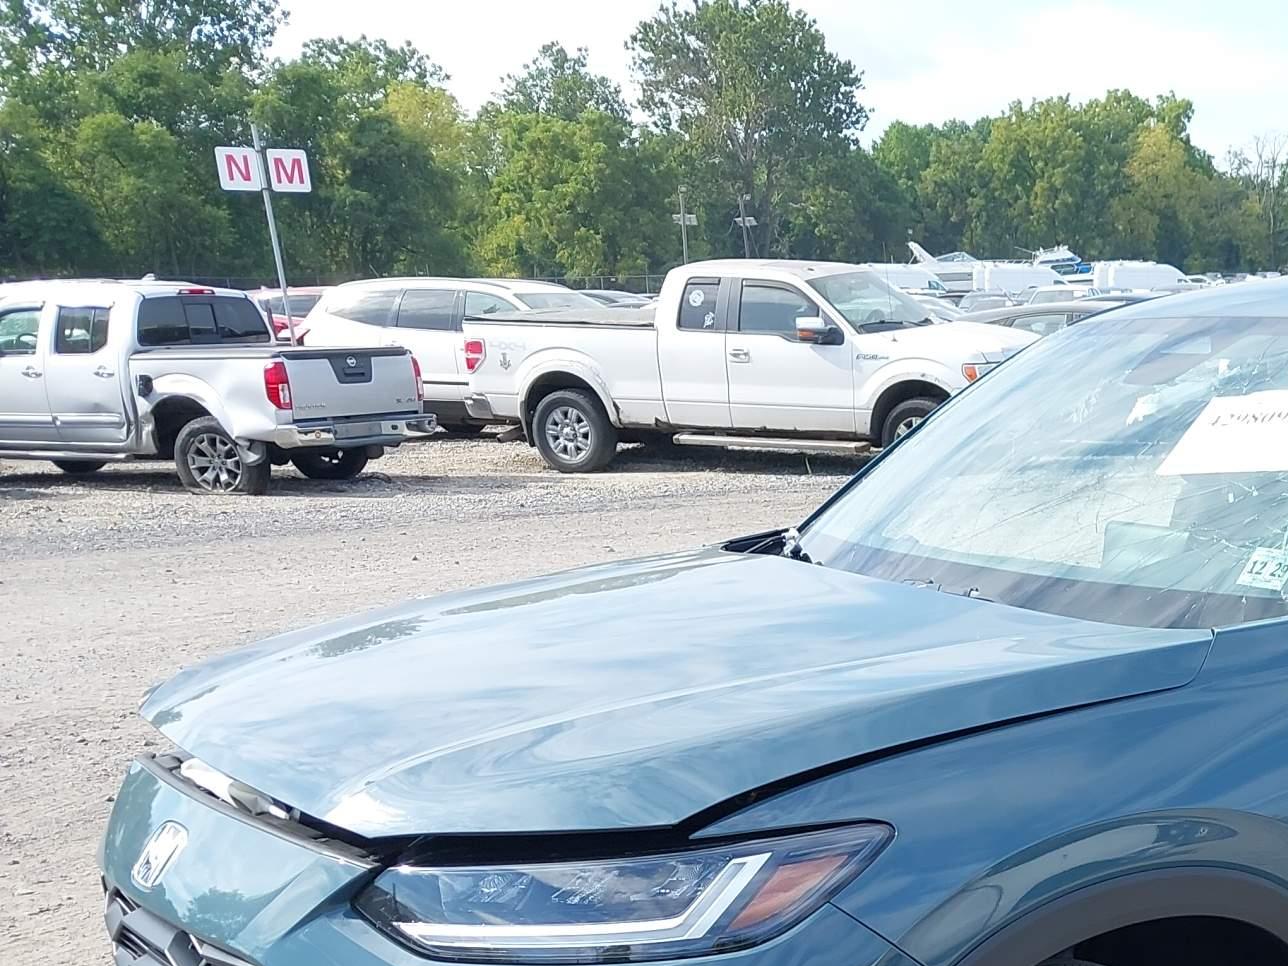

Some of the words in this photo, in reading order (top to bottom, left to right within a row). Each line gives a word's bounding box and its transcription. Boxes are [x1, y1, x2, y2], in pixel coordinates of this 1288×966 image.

[225, 154, 252, 181] N
[273, 158, 304, 184] M
[1247, 560, 1268, 575] 12
